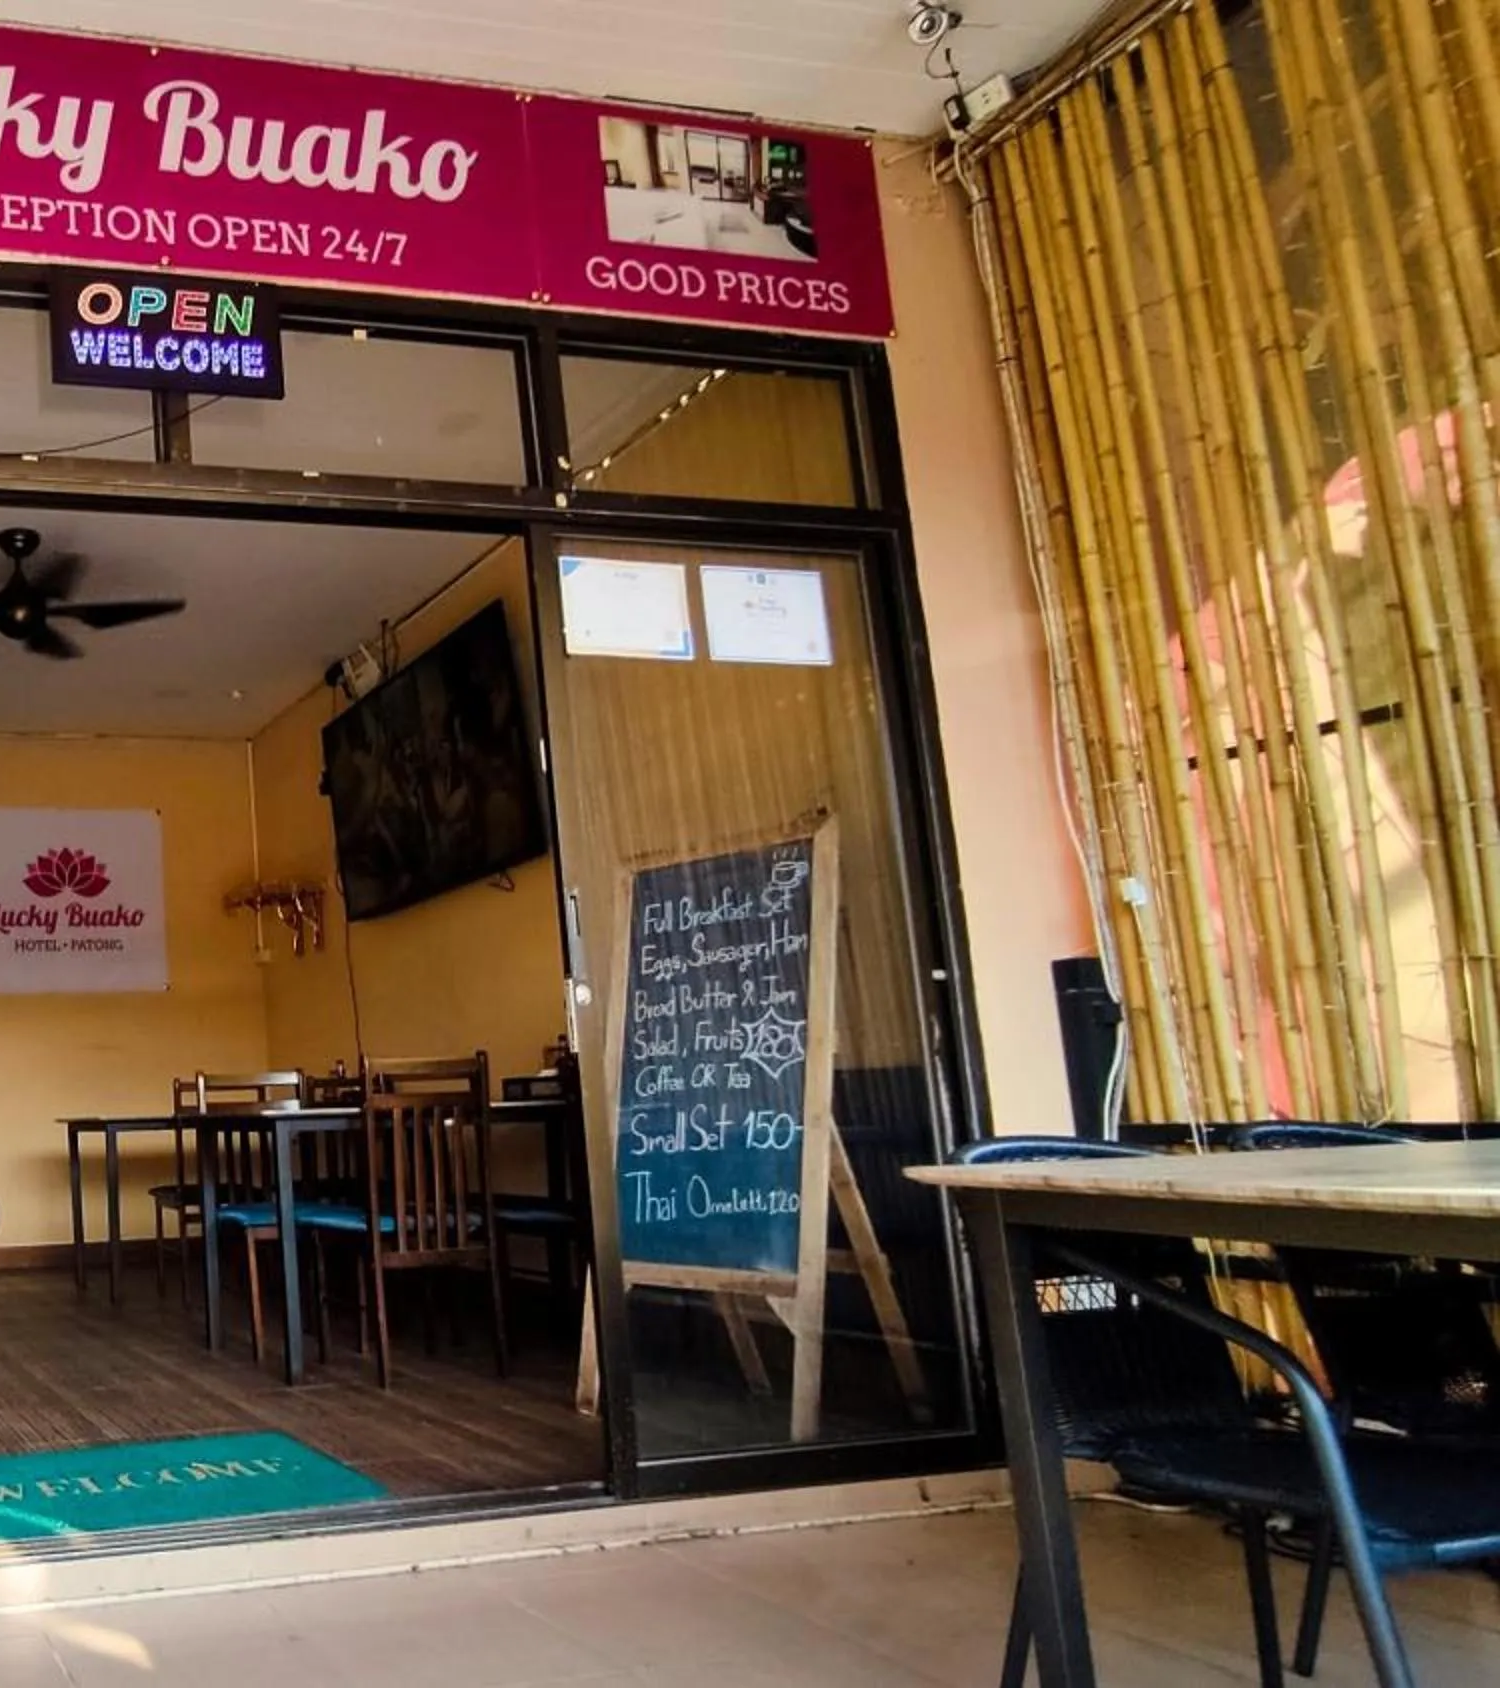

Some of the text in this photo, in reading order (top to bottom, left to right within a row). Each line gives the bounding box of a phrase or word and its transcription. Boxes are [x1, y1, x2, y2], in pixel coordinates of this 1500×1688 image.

[143, 79, 480, 203] Buako
[187, 214, 311, 258] OPEN
[320, 226, 409, 266] 24/7
[77, 283, 254, 337] OPEN
[585, 256, 851, 314] GOOD PRICES
[70, 329, 266, 379] WELCOME
[65, 902, 145, 928] Buako
[644, 886, 793, 935] Full Breakfast Set
[14, 938, 124, 953] HOTEL PATONG
[634, 985, 676, 1023] Bread
[680, 980, 737, 1014] Butter
[759, 975, 797, 1005] Jam
[695, 1017, 744, 1052] Fruits
[635, 1065, 685, 1097] Coffee
[724, 1063, 752, 1089] Tea
[630, 1111, 685, 1155] Small
[689, 1103, 735, 1151] Set
[623, 1171, 678, 1223] Thai
